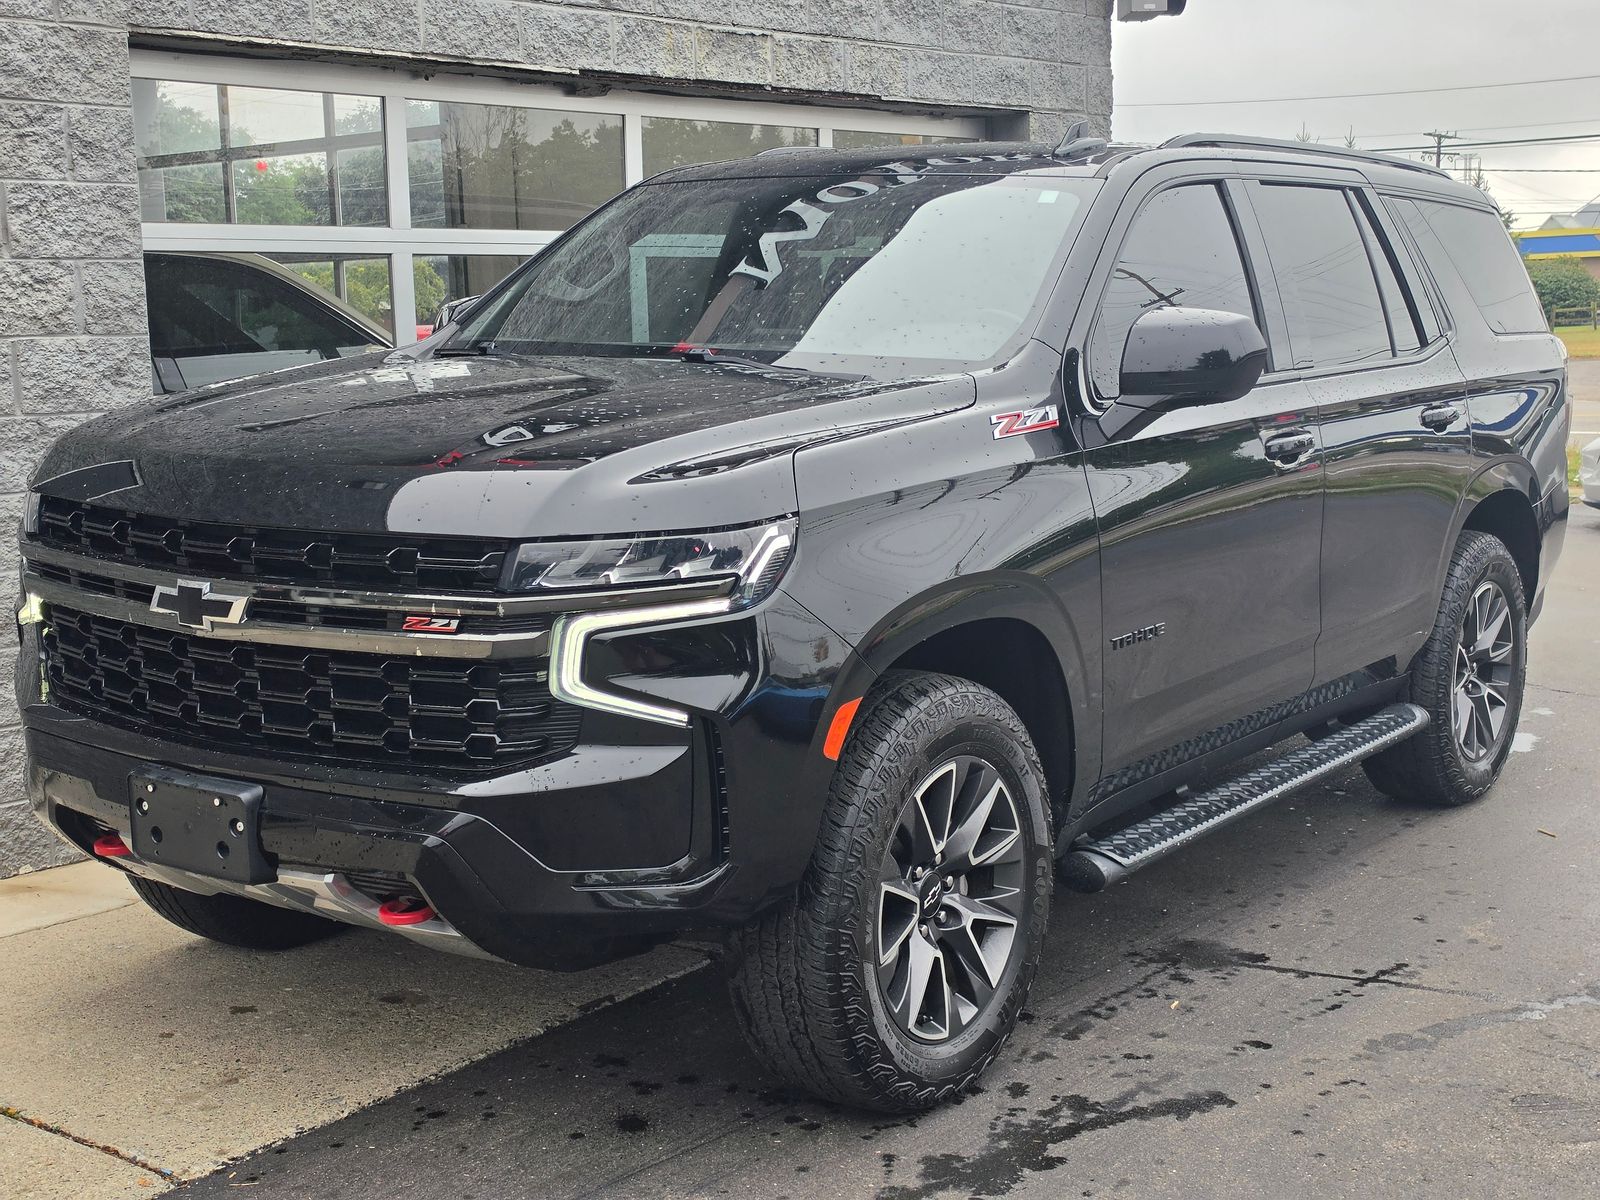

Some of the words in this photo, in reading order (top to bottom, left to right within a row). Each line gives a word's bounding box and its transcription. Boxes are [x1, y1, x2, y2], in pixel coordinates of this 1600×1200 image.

[989, 404, 1060, 440] Z71
[402, 616, 460, 633] Z71
[1110, 622, 1166, 651] TAHOE
